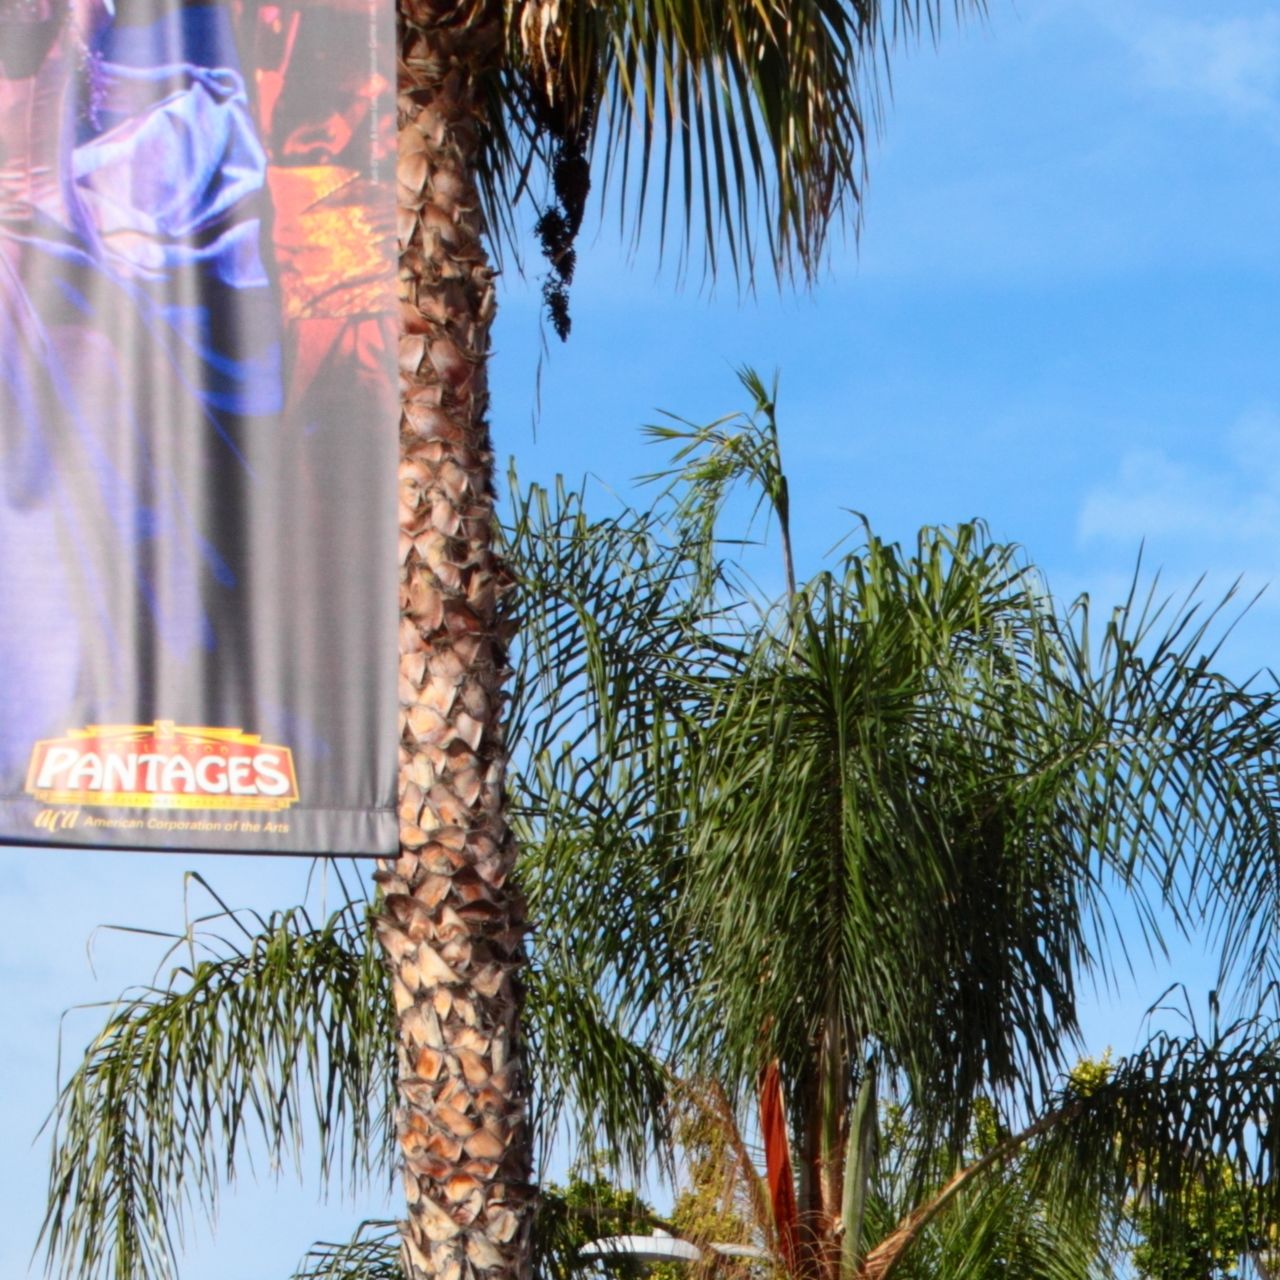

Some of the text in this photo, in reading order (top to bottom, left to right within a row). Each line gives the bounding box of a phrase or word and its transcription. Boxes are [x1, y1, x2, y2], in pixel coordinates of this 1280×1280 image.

[36, 747, 290, 796] PANTAGES
[84, 815, 145, 830] American
[147, 817, 221, 832] Corporation
[223, 819, 239, 832] of
[240, 820, 261, 833] the
[263, 821, 290, 834] Arts
